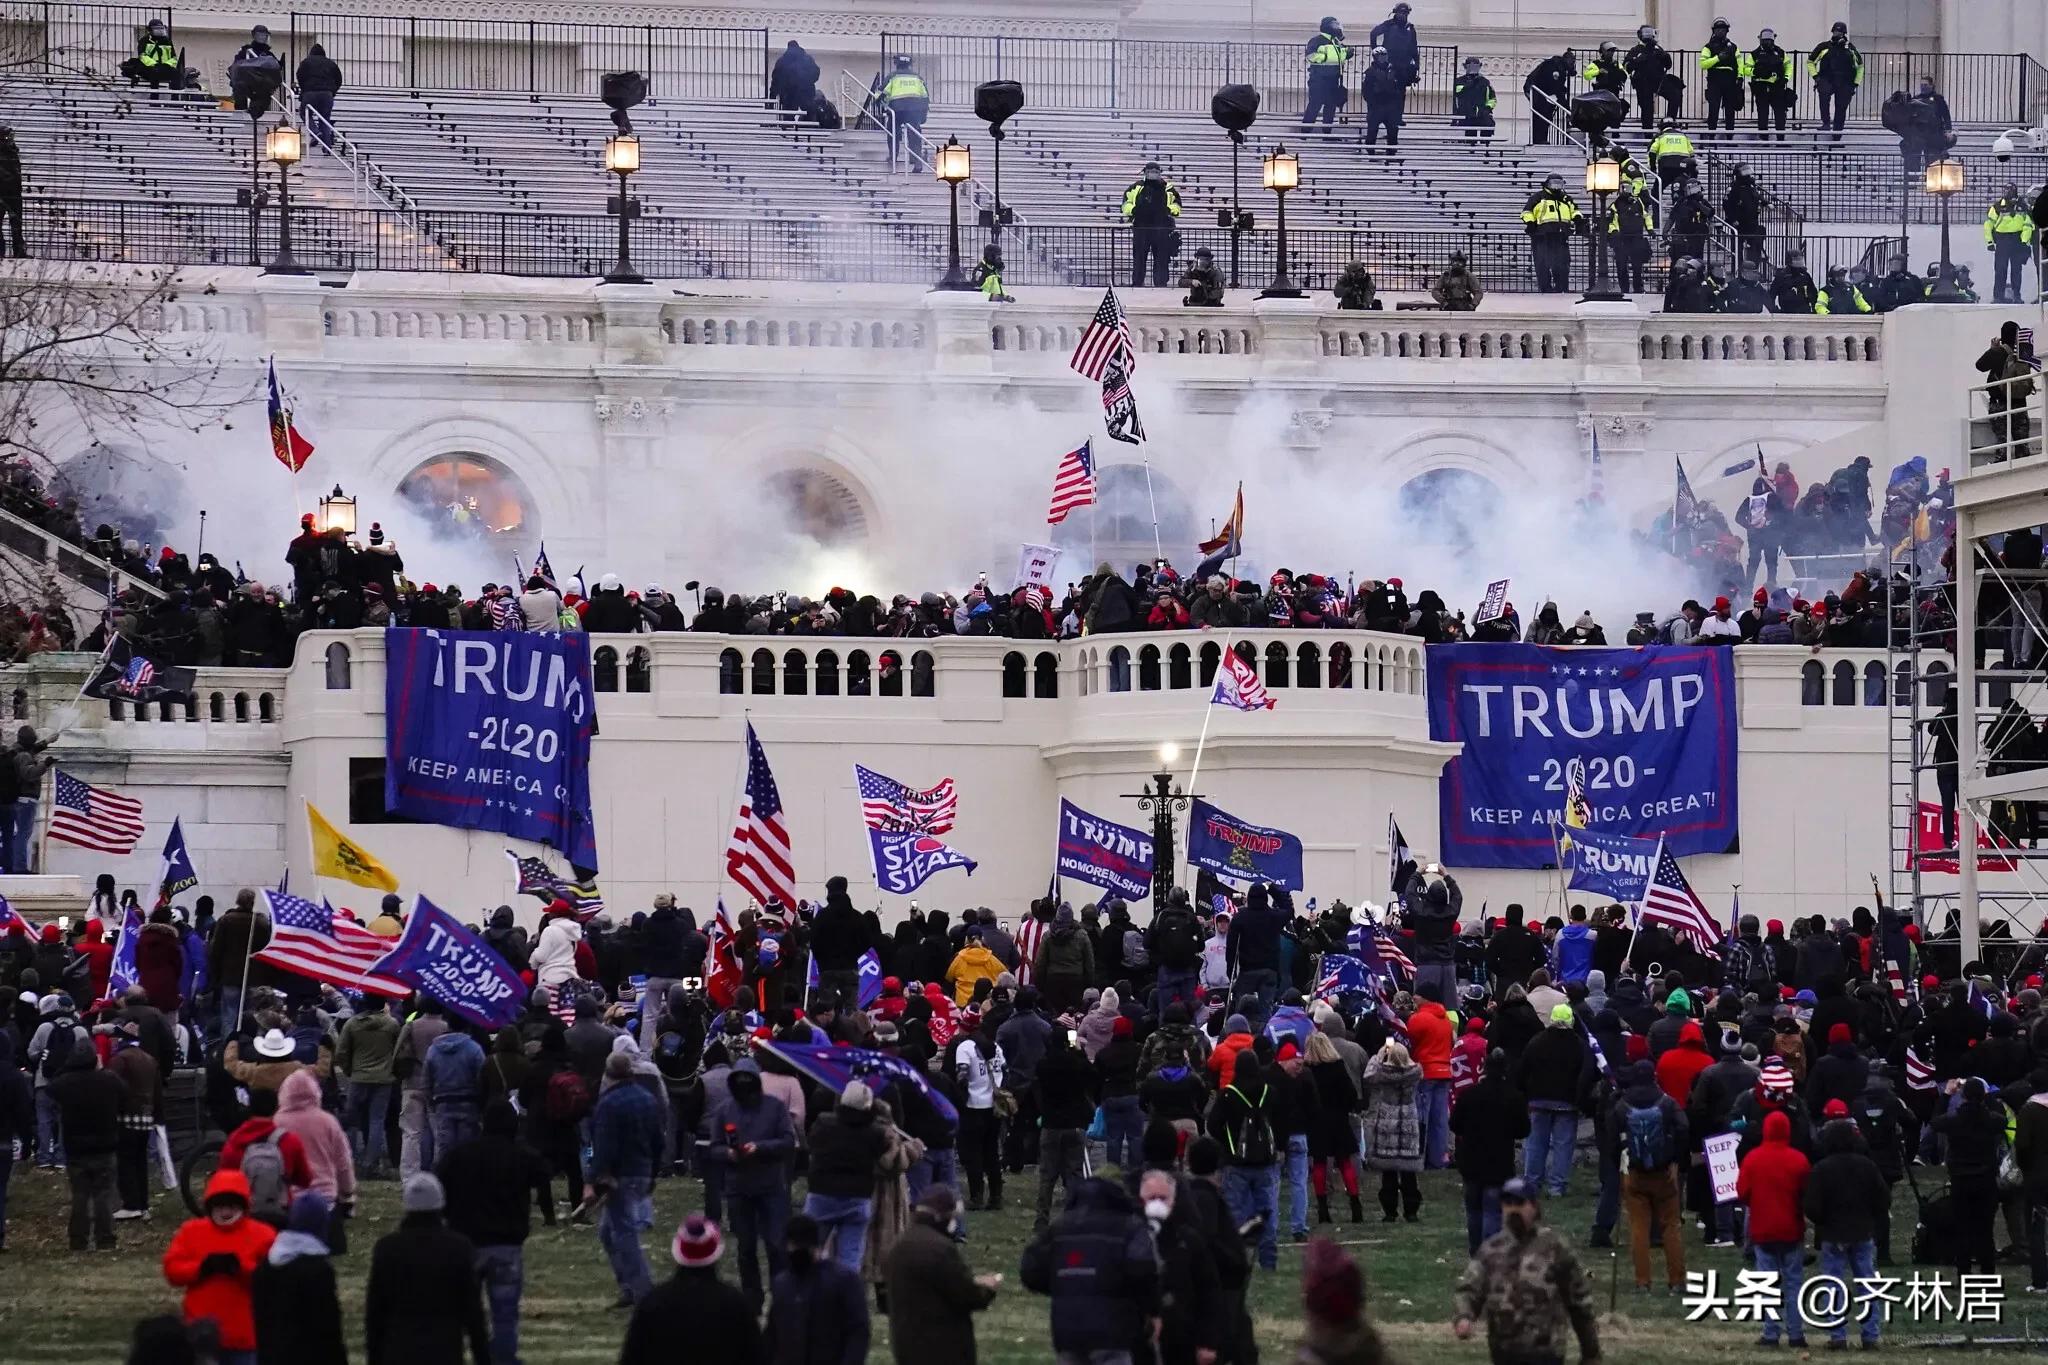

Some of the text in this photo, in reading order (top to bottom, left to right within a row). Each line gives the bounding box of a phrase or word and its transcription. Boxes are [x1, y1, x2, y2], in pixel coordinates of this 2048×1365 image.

[1491, 581, 1506, 617] TRUMP
[1463, 674, 1704, 738] TRUMP
[407, 756, 457, 780] KEEP
[465, 767, 543, 796] AMECA
[1471, 791, 1716, 825] KEEP AMICA GREAT!
[1066, 810, 1153, 863] TRUMP
[1207, 820, 1282, 855] TRUMP
[1061, 857, 1077, 868] NO
[1078, 861, 1109, 879] MORE
[1200, 857, 1258, 878] KEEP AMERICA
[426, 922, 512, 1002] TRUMP
[1708, 1141, 1731, 1154] KEEP
[1712, 1164, 1726, 1174] TO
[1716, 1182, 1735, 1195] CON
